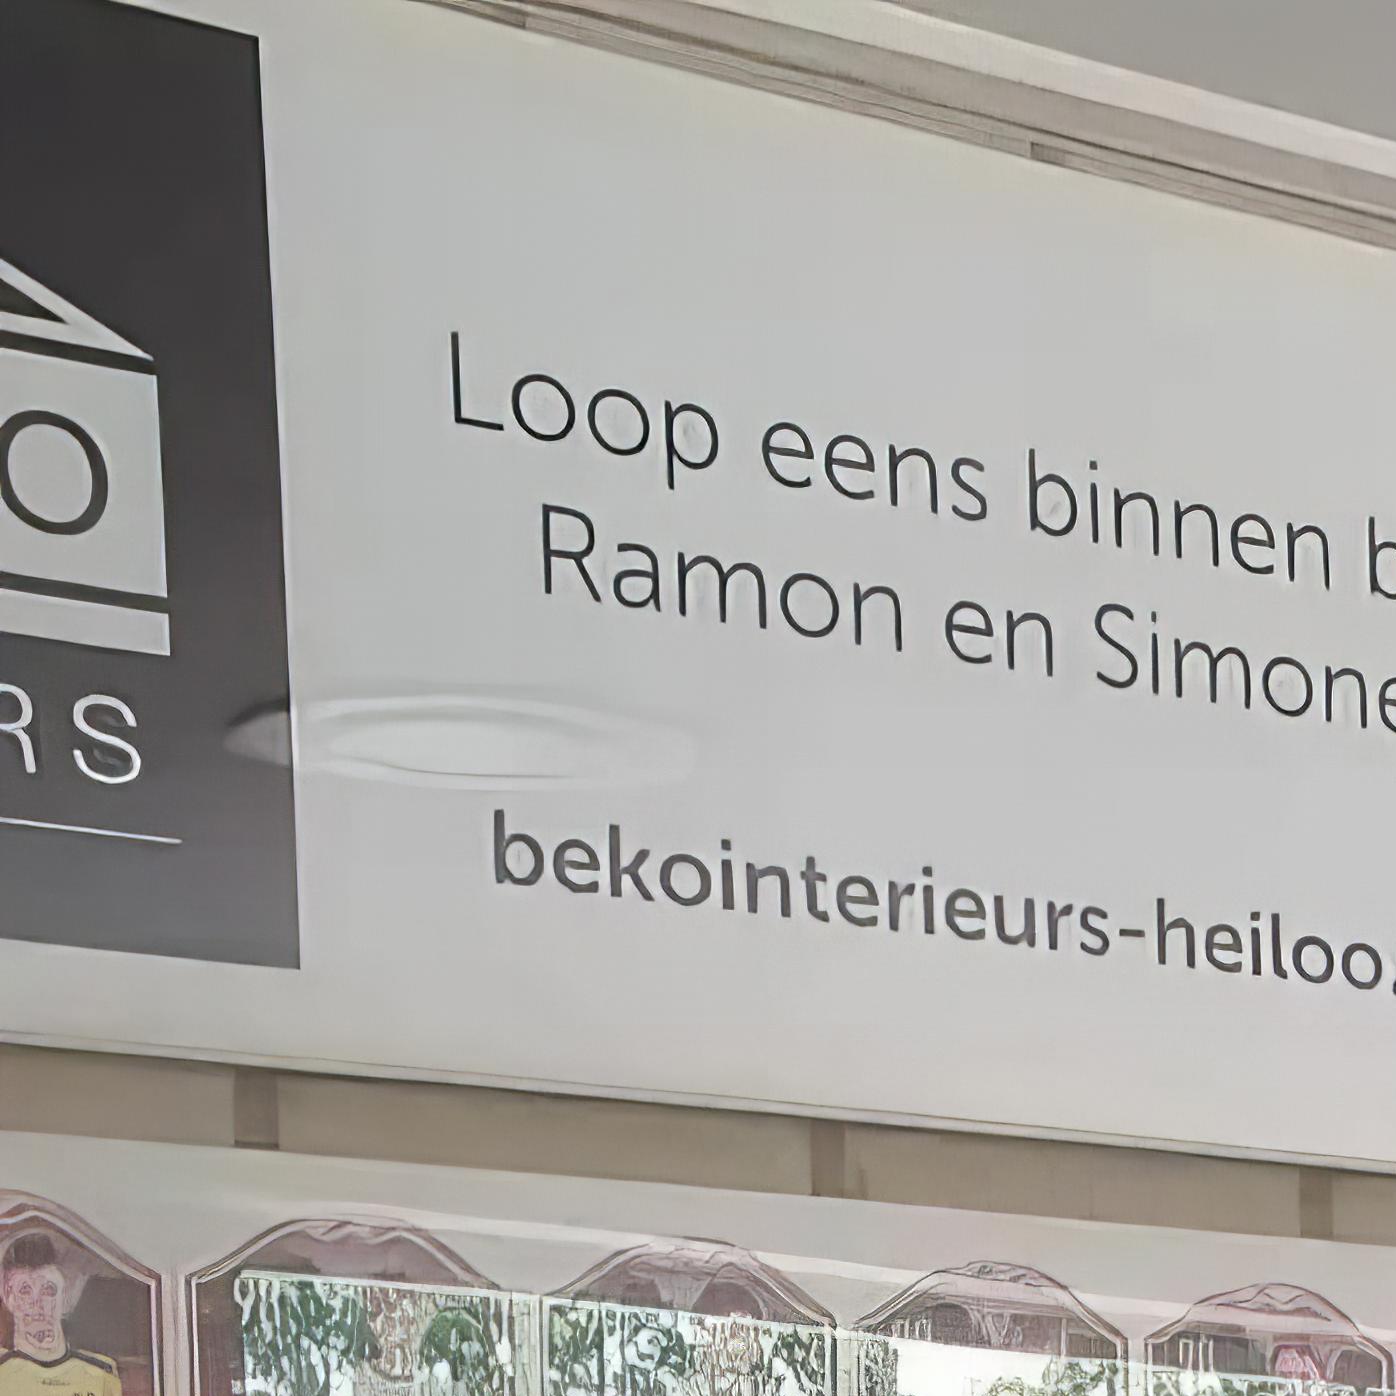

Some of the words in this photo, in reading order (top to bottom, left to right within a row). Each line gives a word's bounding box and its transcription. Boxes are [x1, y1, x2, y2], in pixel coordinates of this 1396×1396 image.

[449, 329, 721, 493] Loop
[760, 420, 989, 523] eens
[1027, 446, 1333, 593] binnen
[540, 501, 905, 655] Ramon
[943, 599, 1055, 680] en
